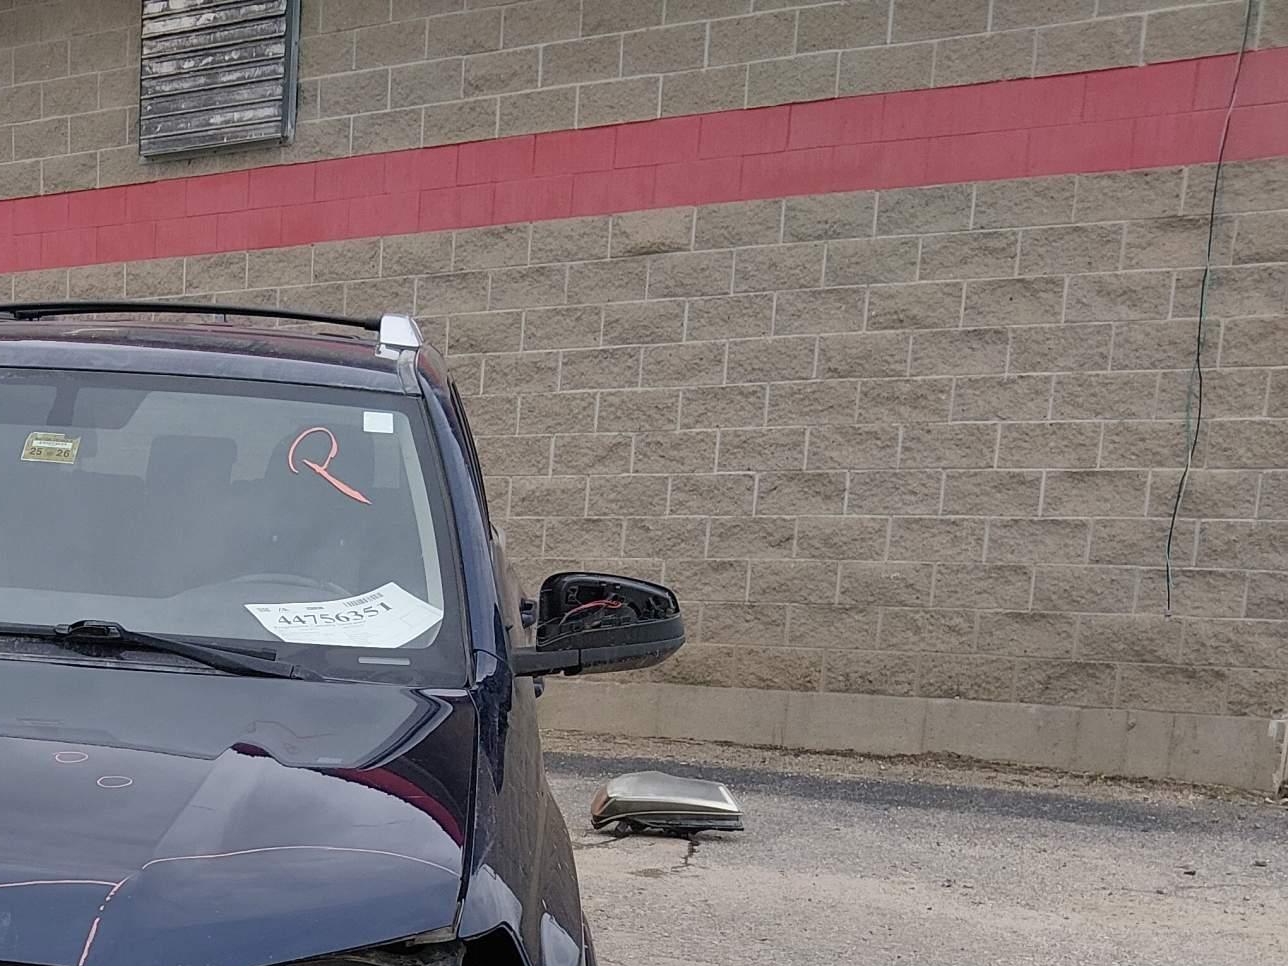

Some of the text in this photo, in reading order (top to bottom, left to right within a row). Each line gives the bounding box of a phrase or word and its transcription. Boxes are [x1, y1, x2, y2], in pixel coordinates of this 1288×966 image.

[29, 447, 71, 458] 25 26
[278, 602, 393, 625] 44756351
